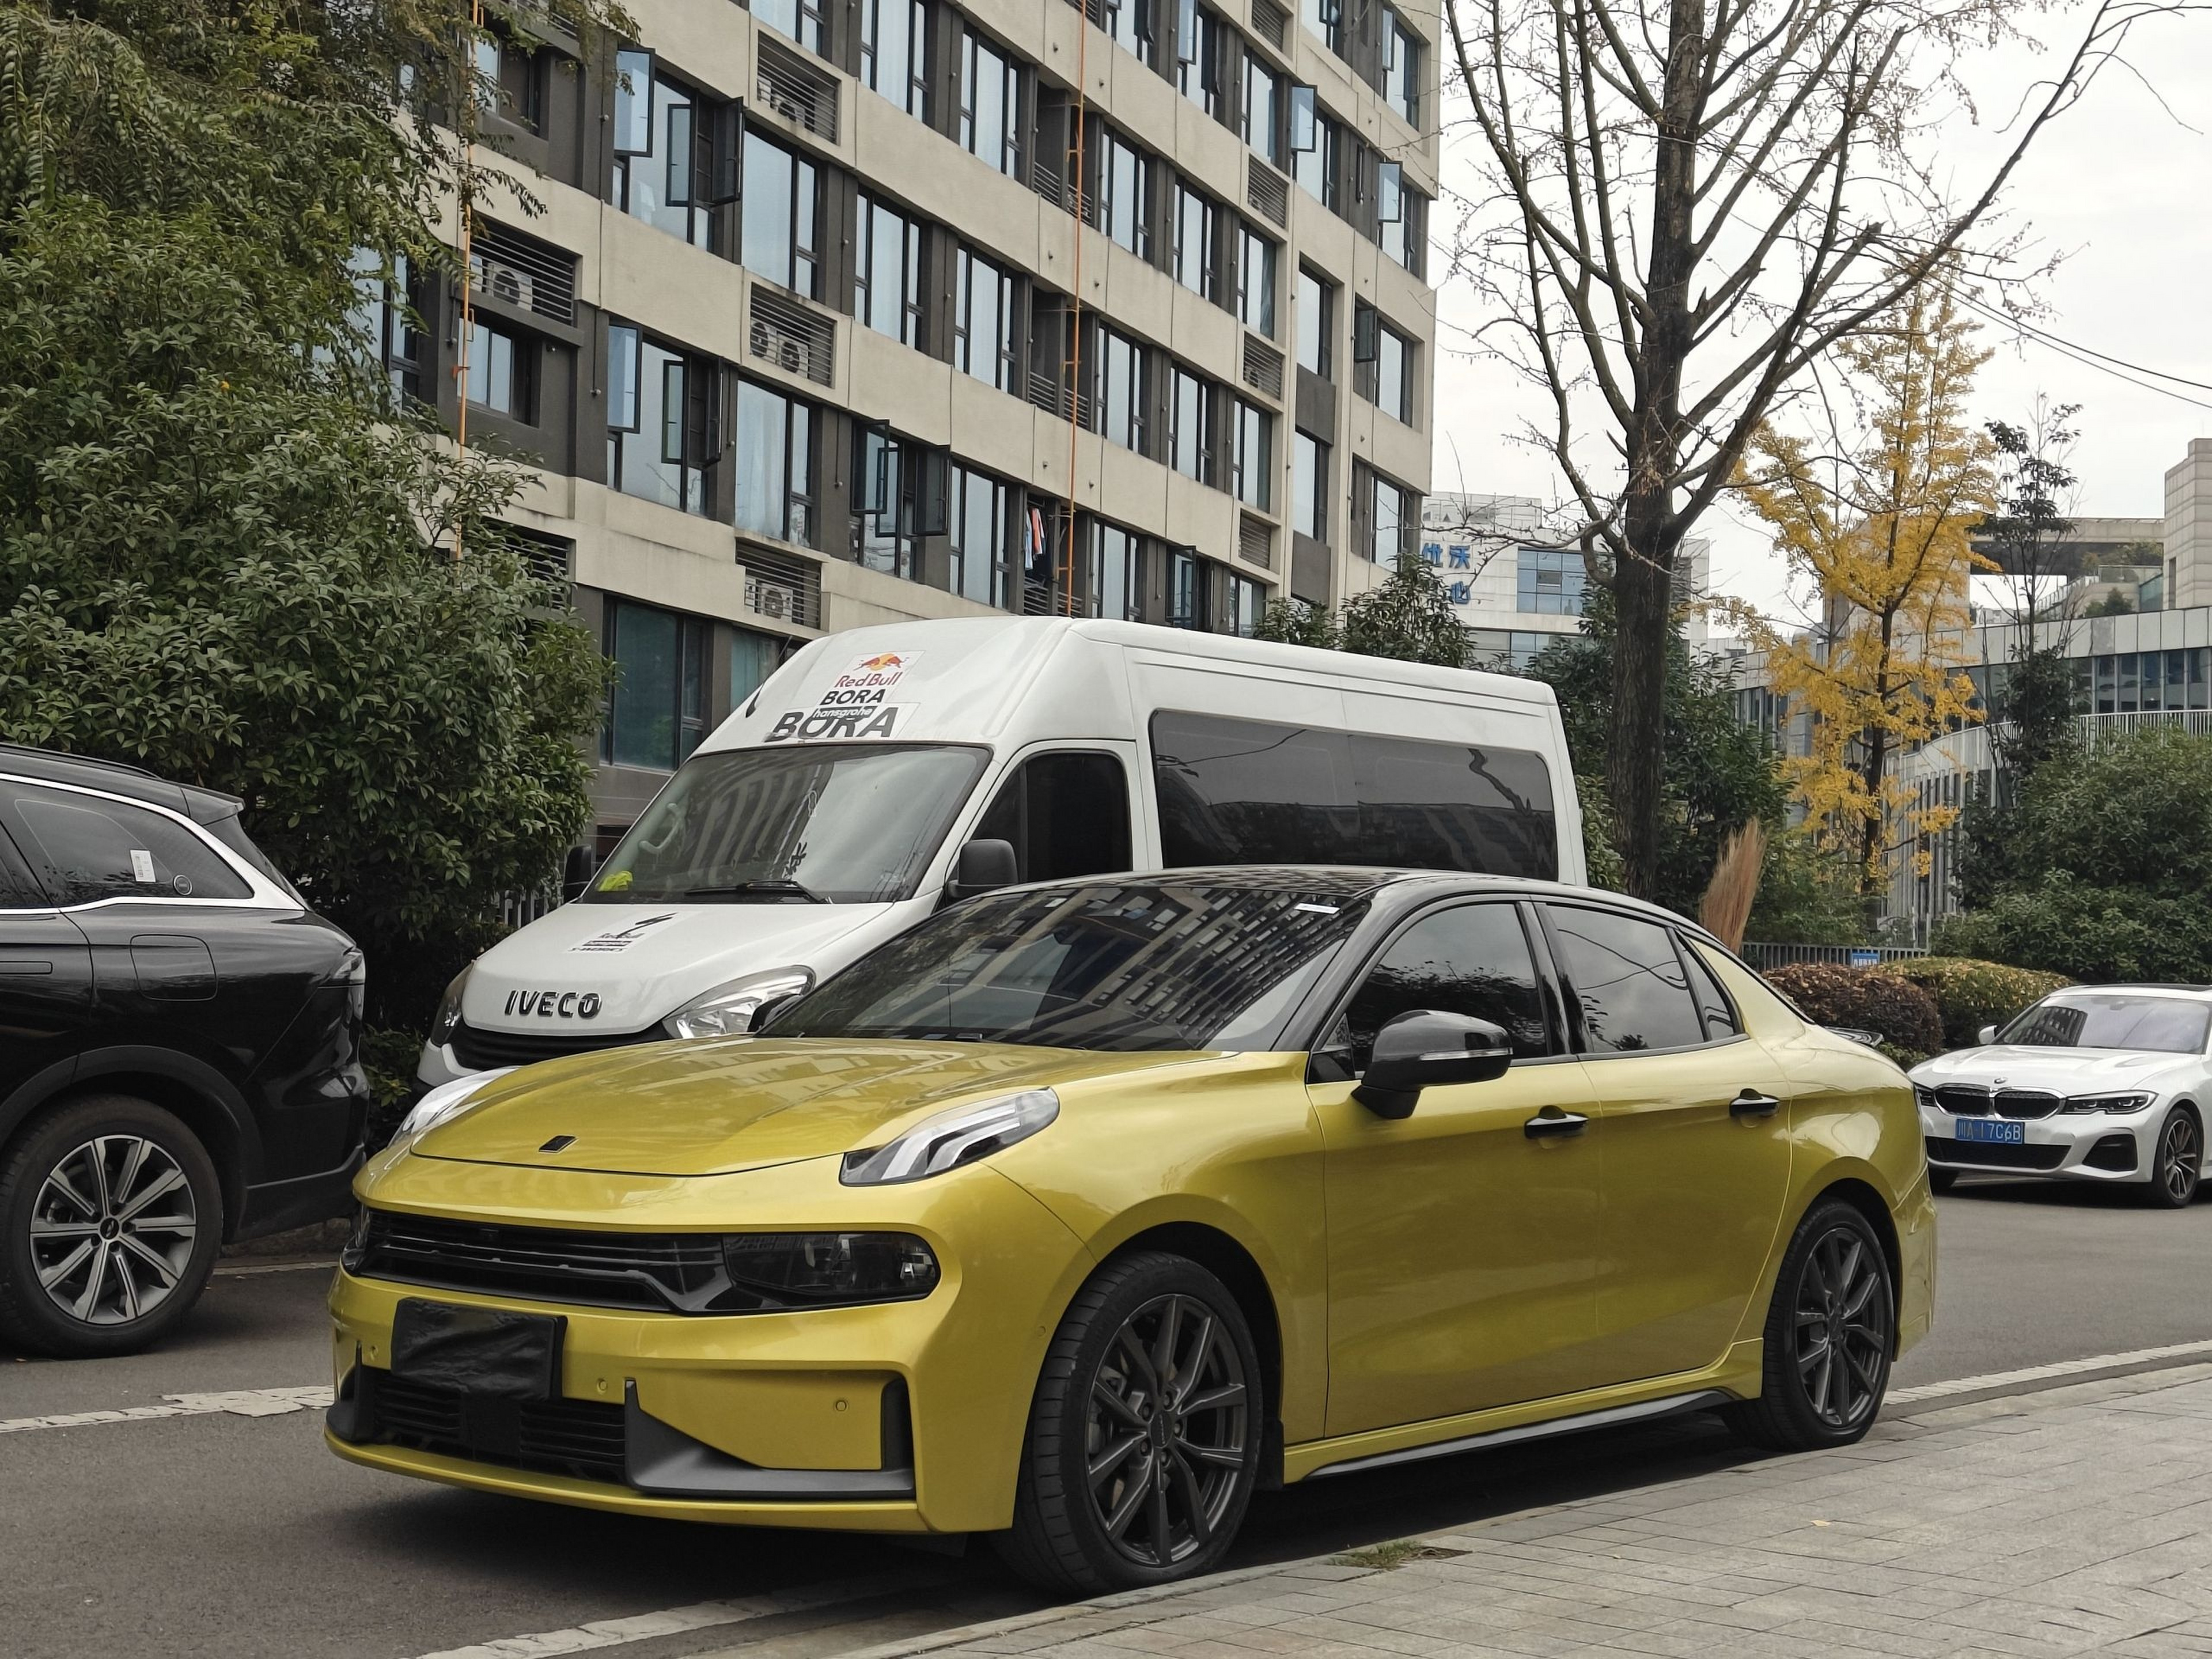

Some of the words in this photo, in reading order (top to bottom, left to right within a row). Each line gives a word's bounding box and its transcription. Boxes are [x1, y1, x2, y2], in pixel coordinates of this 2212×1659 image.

[820, 689, 886, 705] BORA
[813, 706, 873, 718] hansgrohe
[764, 707, 898, 743] BORA
[504, 990, 602, 1019] IVECO
